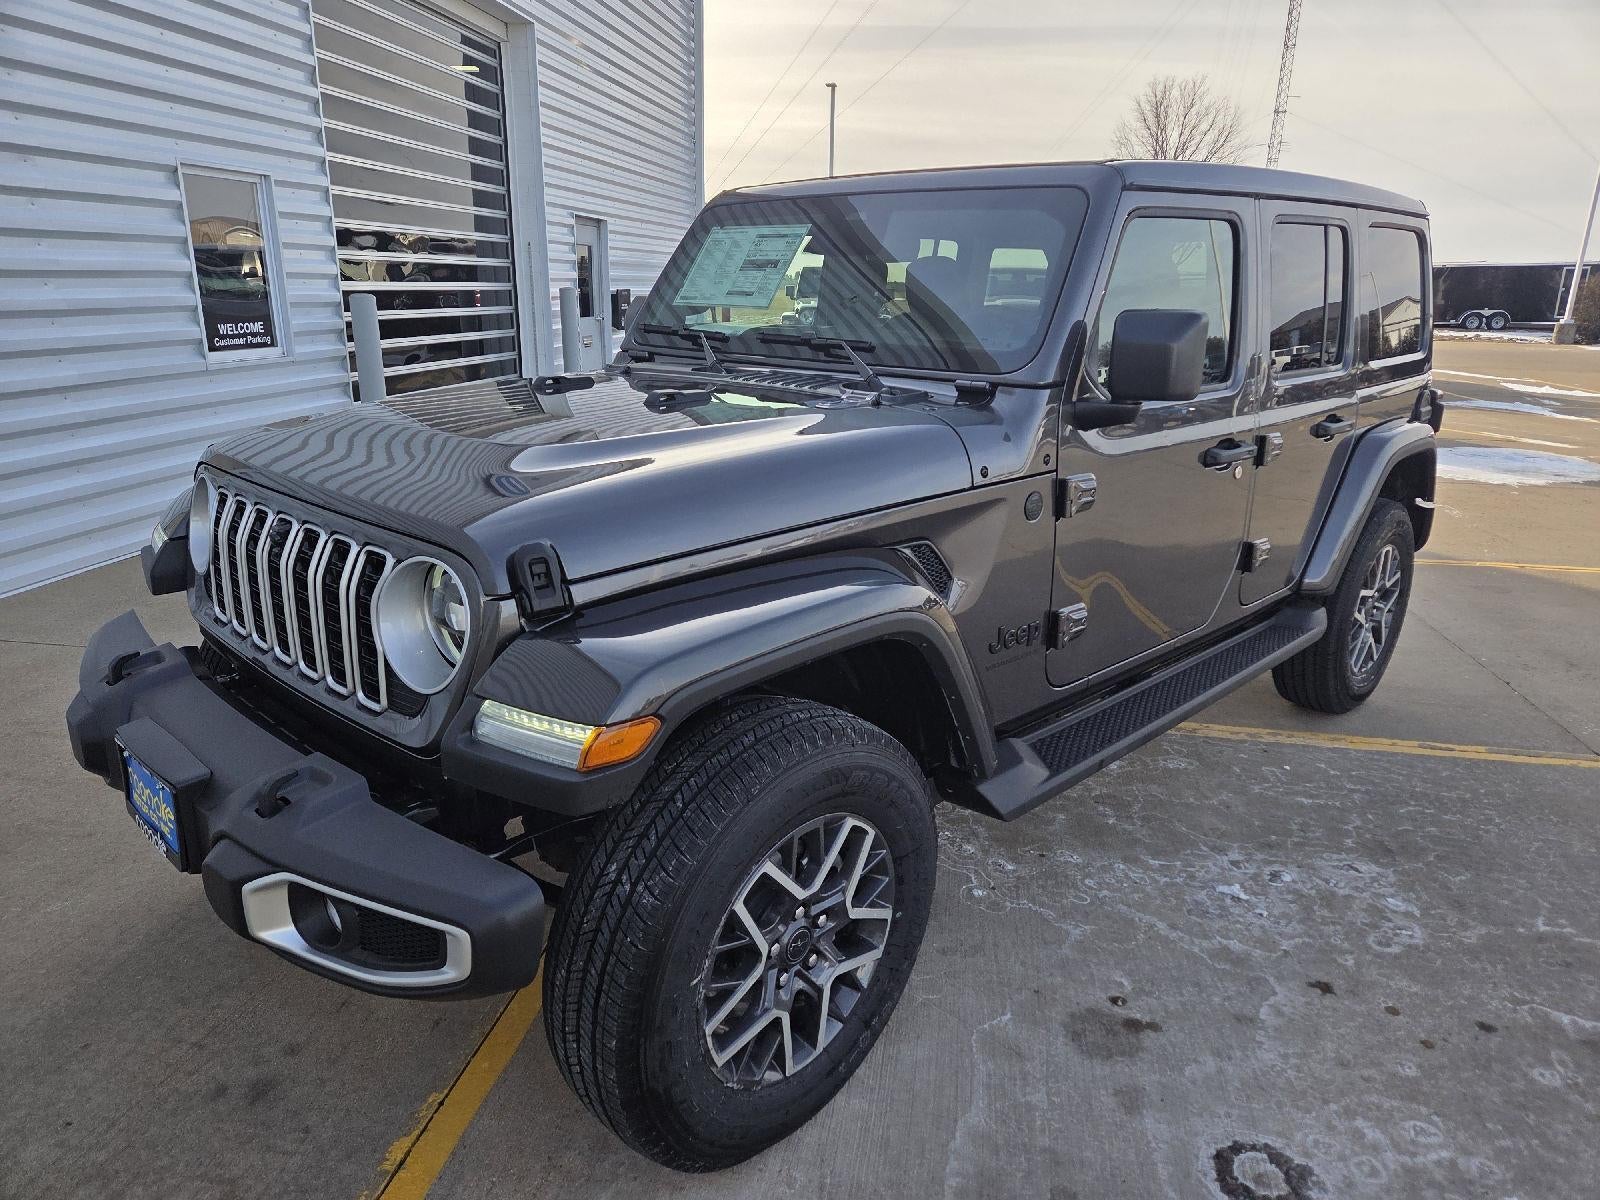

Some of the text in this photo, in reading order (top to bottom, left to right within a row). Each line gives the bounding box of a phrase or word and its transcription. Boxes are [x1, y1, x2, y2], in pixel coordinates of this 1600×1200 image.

[217, 321, 265, 335] WELCOME
[214, 334, 271, 347] Customer Parking
[988, 620, 1041, 655] Jeep
